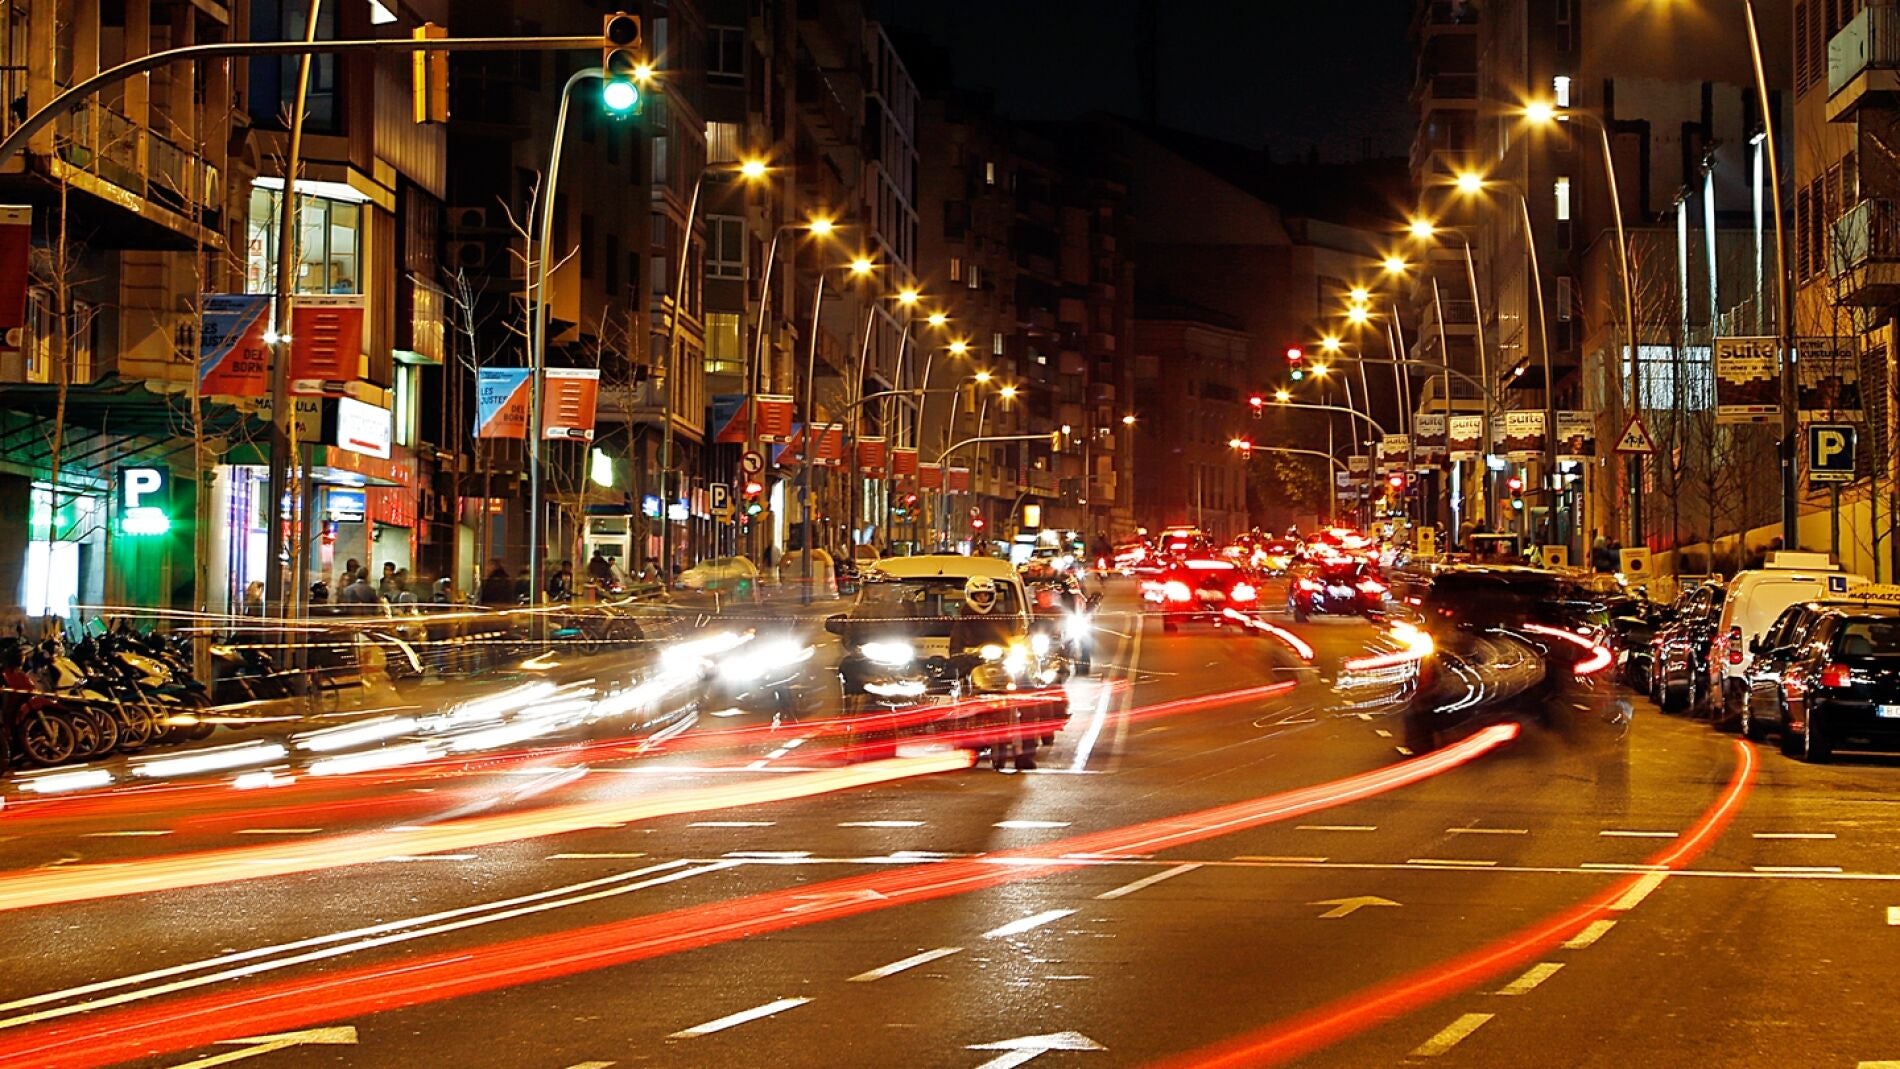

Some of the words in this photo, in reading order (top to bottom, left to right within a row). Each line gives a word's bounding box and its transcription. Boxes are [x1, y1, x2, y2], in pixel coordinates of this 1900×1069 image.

[243, 348, 263, 360] DEL
[1720, 341, 1773, 359] suite
[232, 361, 263, 372] BORN
[481, 387, 493, 395] LES
[1508, 412, 1543, 424] suite
[818, 430, 845, 466] P
[125, 469, 162, 508] P
[714, 487, 725, 506] P
[1833, 578, 1843, 590] L
